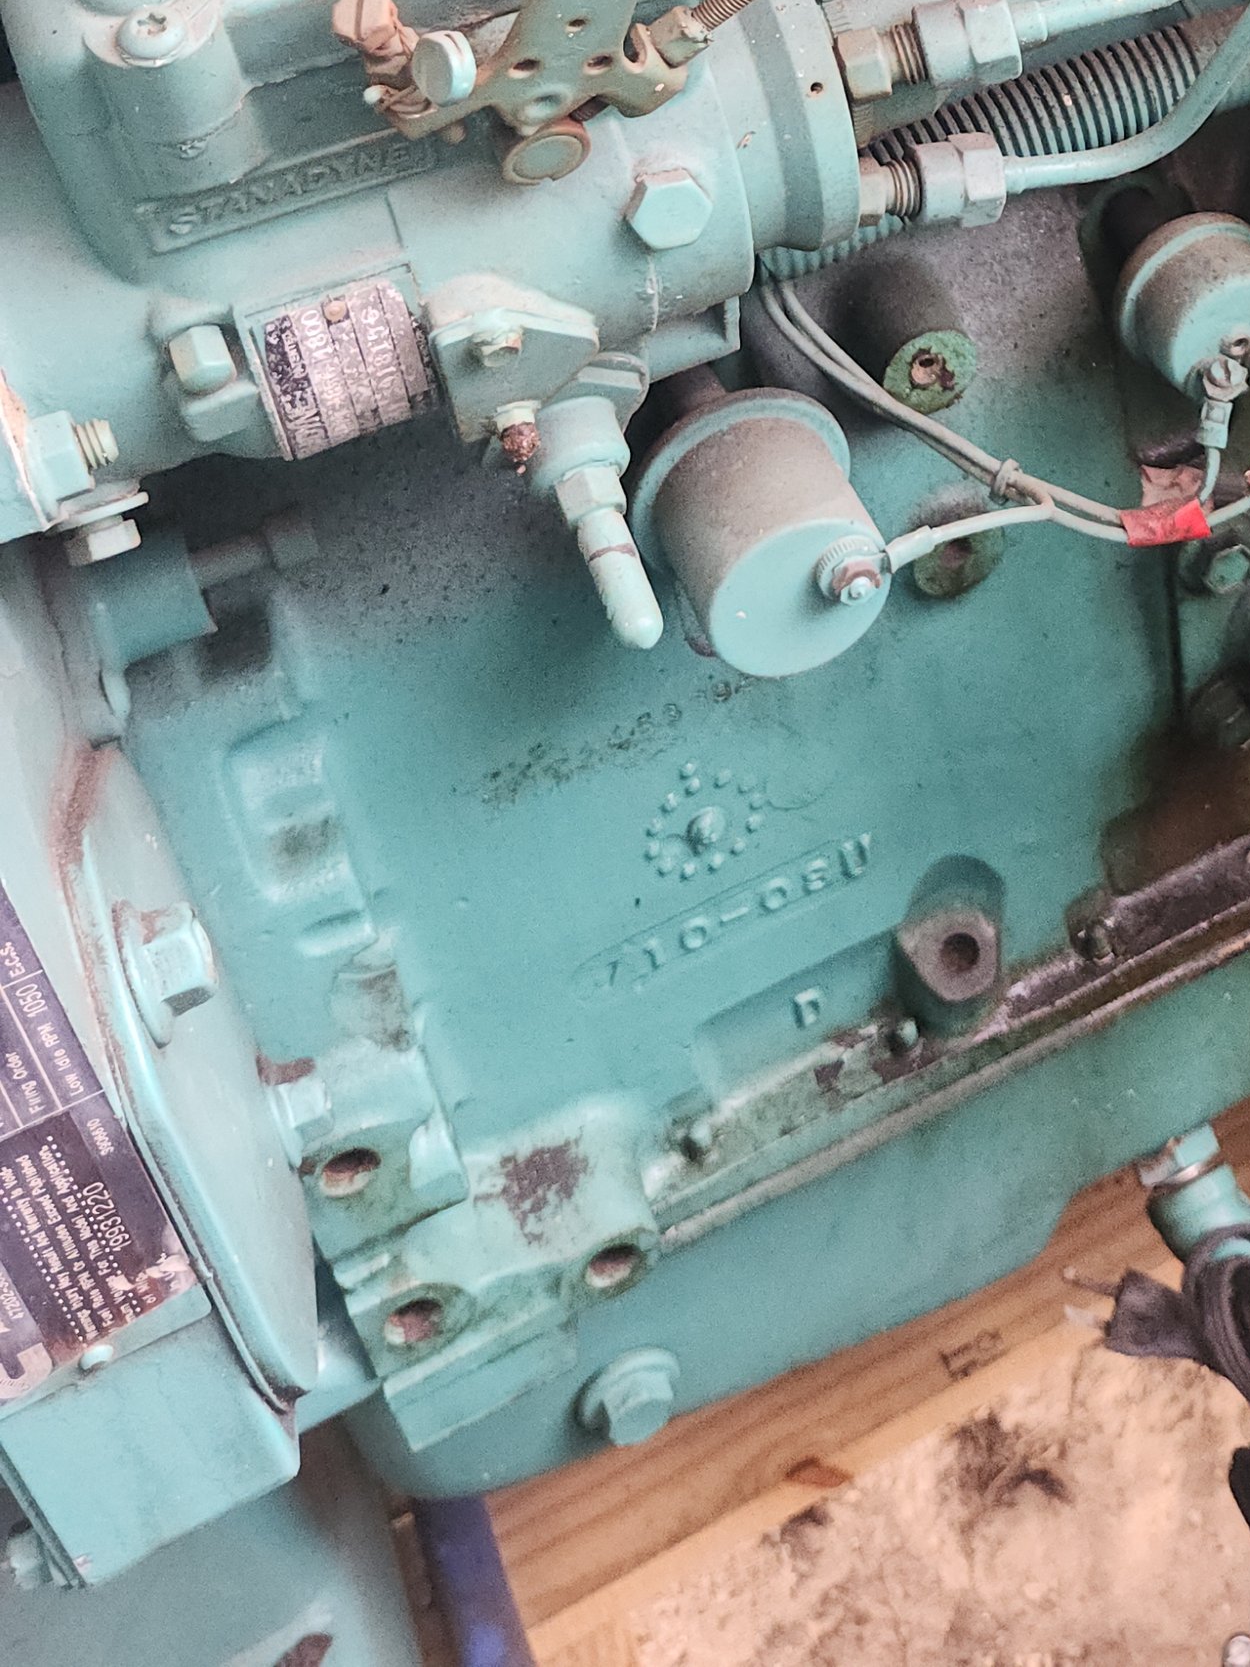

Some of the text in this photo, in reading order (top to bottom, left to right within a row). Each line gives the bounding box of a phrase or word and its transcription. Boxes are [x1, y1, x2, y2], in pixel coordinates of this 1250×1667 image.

[168, 140, 413, 235] STANADYNE
[15, 983, 84, 1096] Low Idle RPM 1050
[6, 1052, 45, 1113] Firing Order
[15, 1155, 46, 1195] Published
[36, 1194, 61, 1224] Exceed
[61, 1195, 80, 1213] And
[82, 1182, 131, 1252] 19931220
[32, 1231, 50, 1247] And
[71, 1214, 93, 1240] Model
[42, 1246, 64, 1273] Result
[87, 1240, 102, 1259] This
[56, 1272, 72, 1289] May
[97, 1260, 111, 1275] For
[89, 1289, 104, 1307] Rate
[97, 1307, 114, 1327] Fuel
